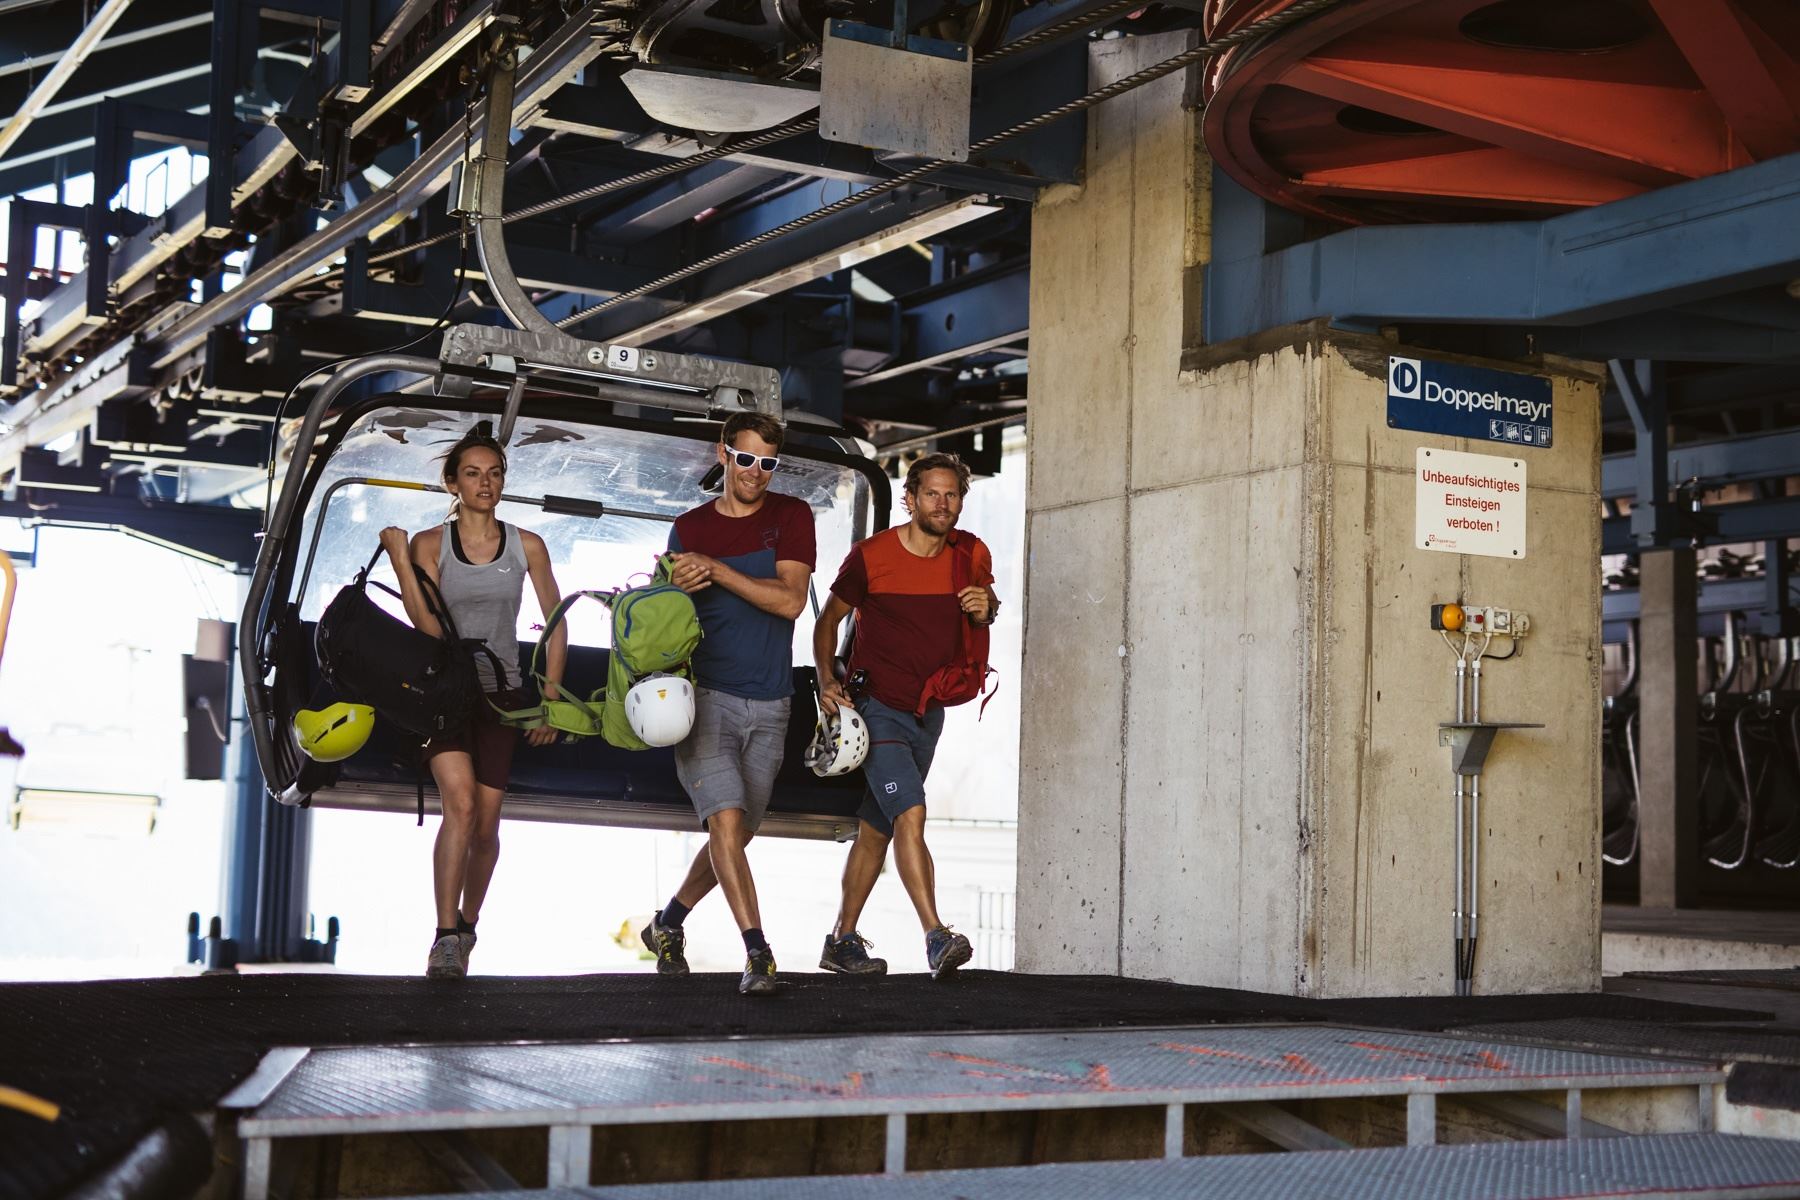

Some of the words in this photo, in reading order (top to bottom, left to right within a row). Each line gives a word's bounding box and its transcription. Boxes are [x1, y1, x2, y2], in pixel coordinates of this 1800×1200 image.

[619, 350, 629, 361] 9
[1425, 380, 1551, 422] Doppelmayr
[1422, 469, 1520, 492] Unbeaufsichtigtes
[1445, 493, 1501, 512] Einsteigen
[1446, 517, 1493, 532] verboten
